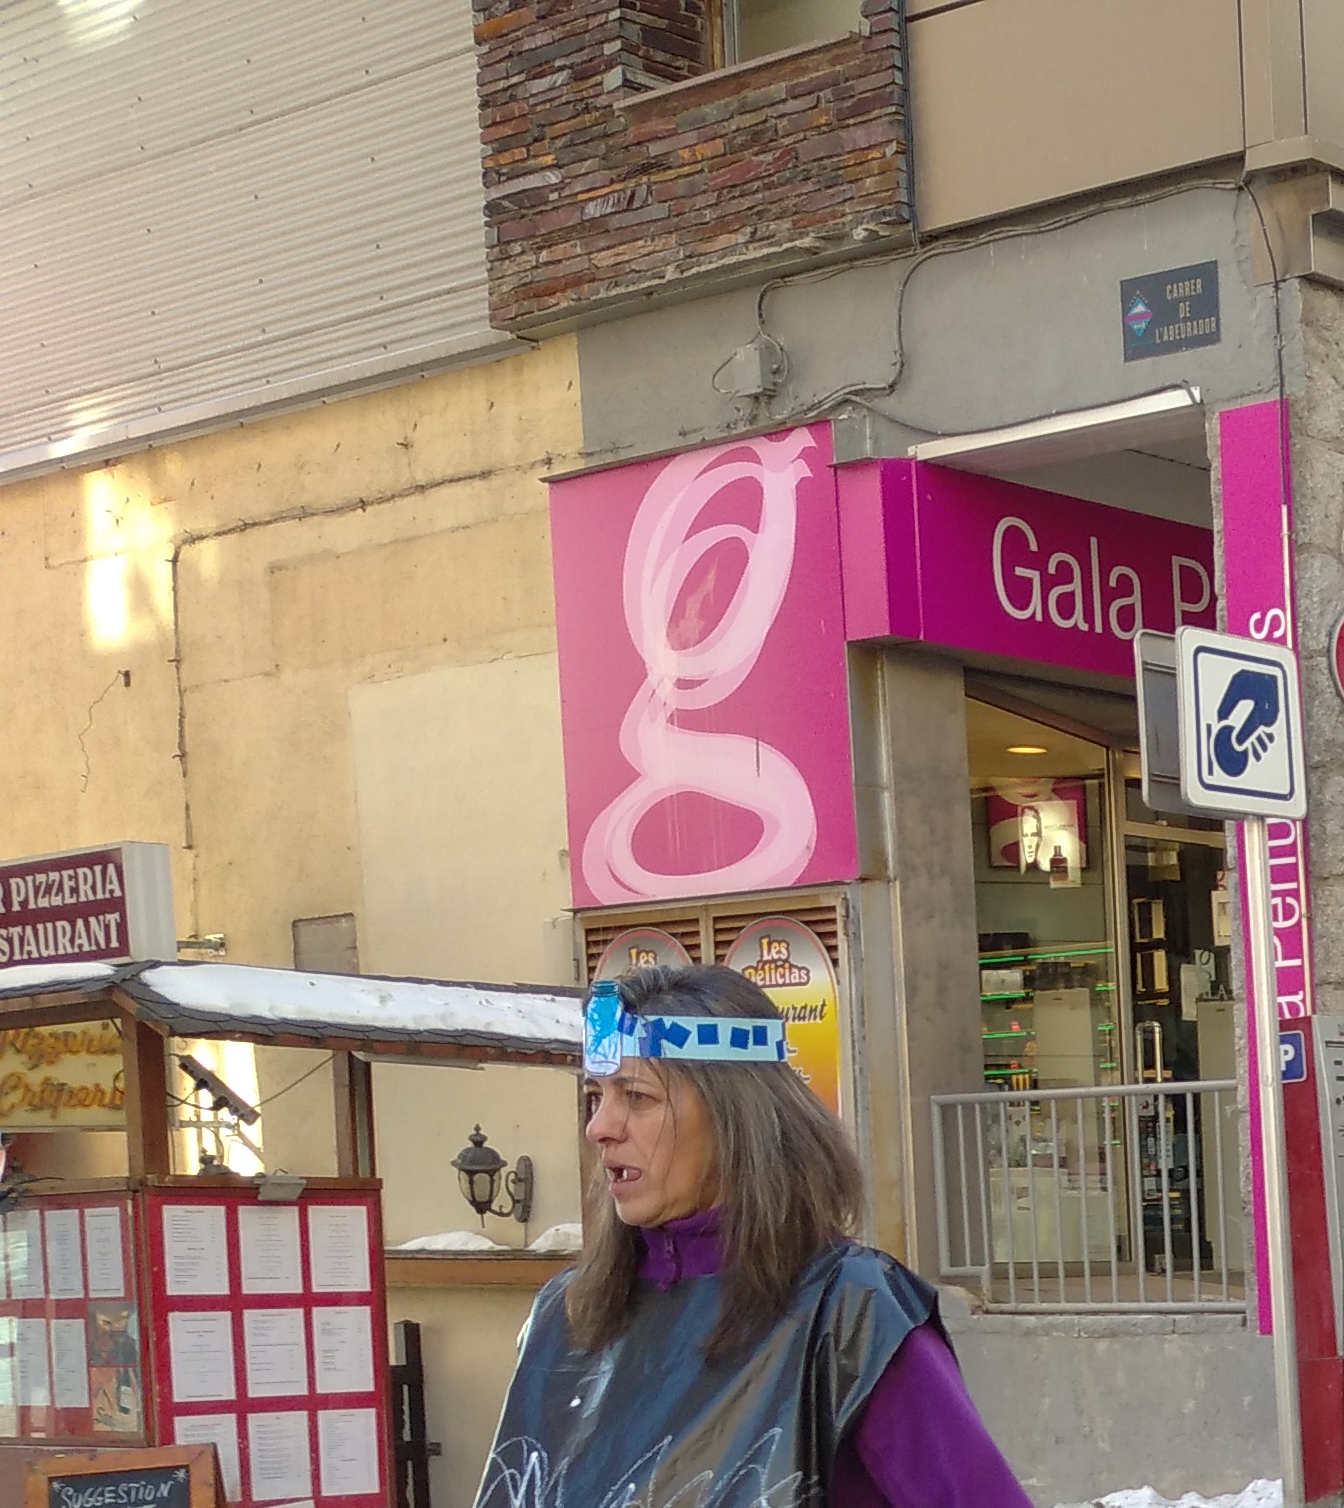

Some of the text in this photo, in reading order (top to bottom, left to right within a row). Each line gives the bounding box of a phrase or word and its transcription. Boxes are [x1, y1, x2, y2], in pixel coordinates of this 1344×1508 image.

[1166, 278, 1202, 300] CARRER
[1179, 301, 1191, 319] DE
[1155, 316, 1217, 343] L'ABEURADOR
[992, 516, 1143, 641] Gala
[9, 862, 123, 912] PIZZERIA
[760, 936, 789, 961] Les
